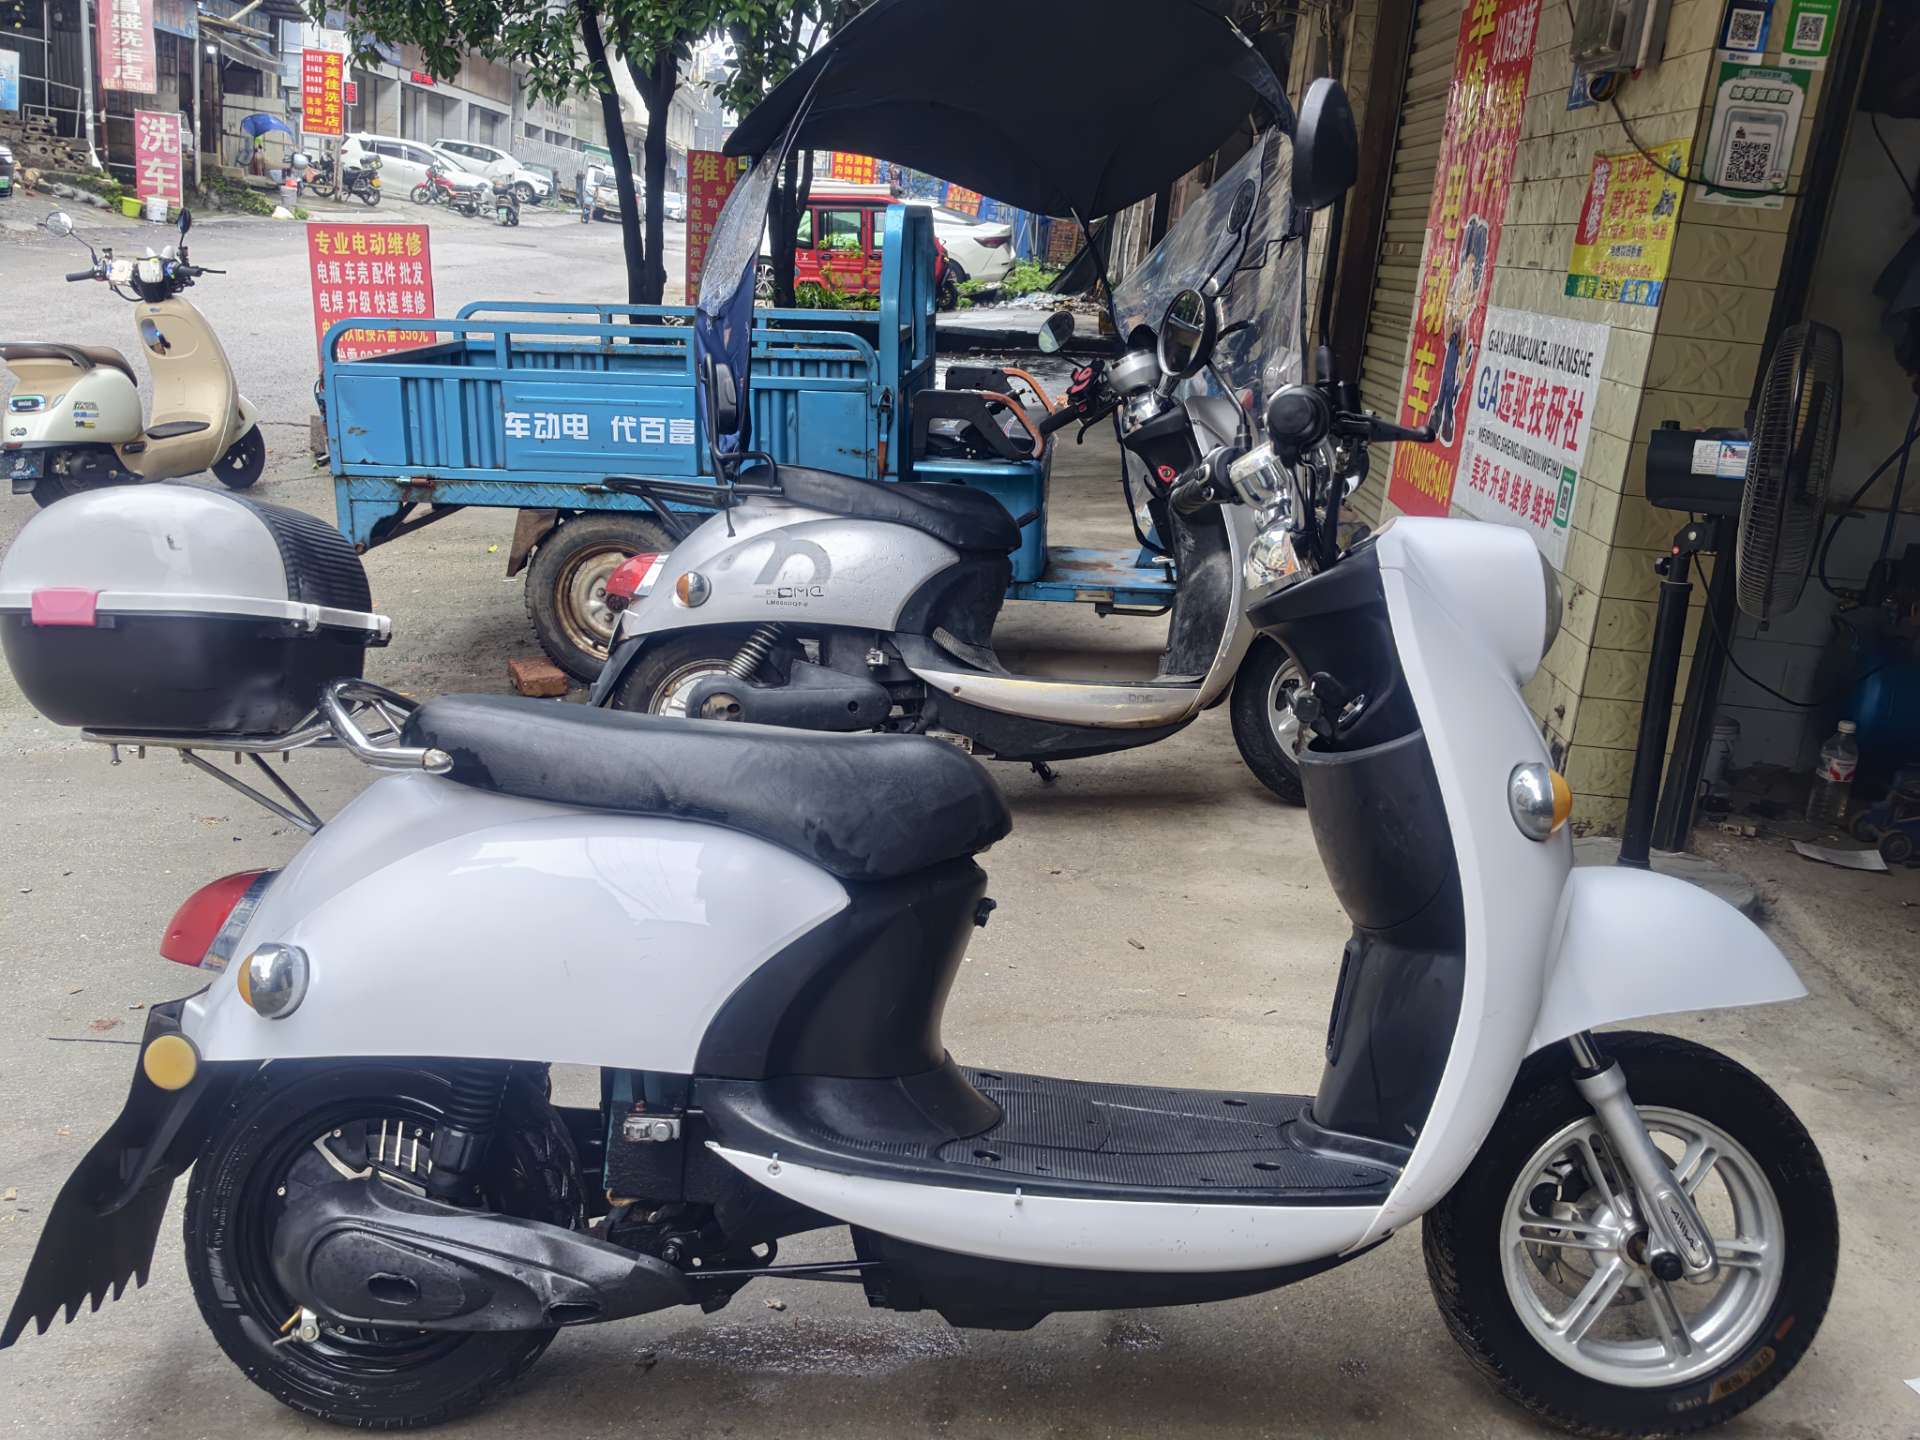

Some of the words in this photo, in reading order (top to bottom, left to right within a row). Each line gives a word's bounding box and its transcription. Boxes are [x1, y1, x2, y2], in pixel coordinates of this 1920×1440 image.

[140, 116, 177, 194] 洗车
[315, 231, 422, 256] 专业电动维修
[317, 261, 342, 285] 电瓶
[344, 261, 369, 285] 车壳
[371, 261, 396, 285] 配件
[399, 261, 424, 285] 批发
[319, 290, 343, 313] 电焊
[347, 290, 371, 314] 升级
[374, 290, 399, 314] 快速
[401, 291, 426, 314] 维修
